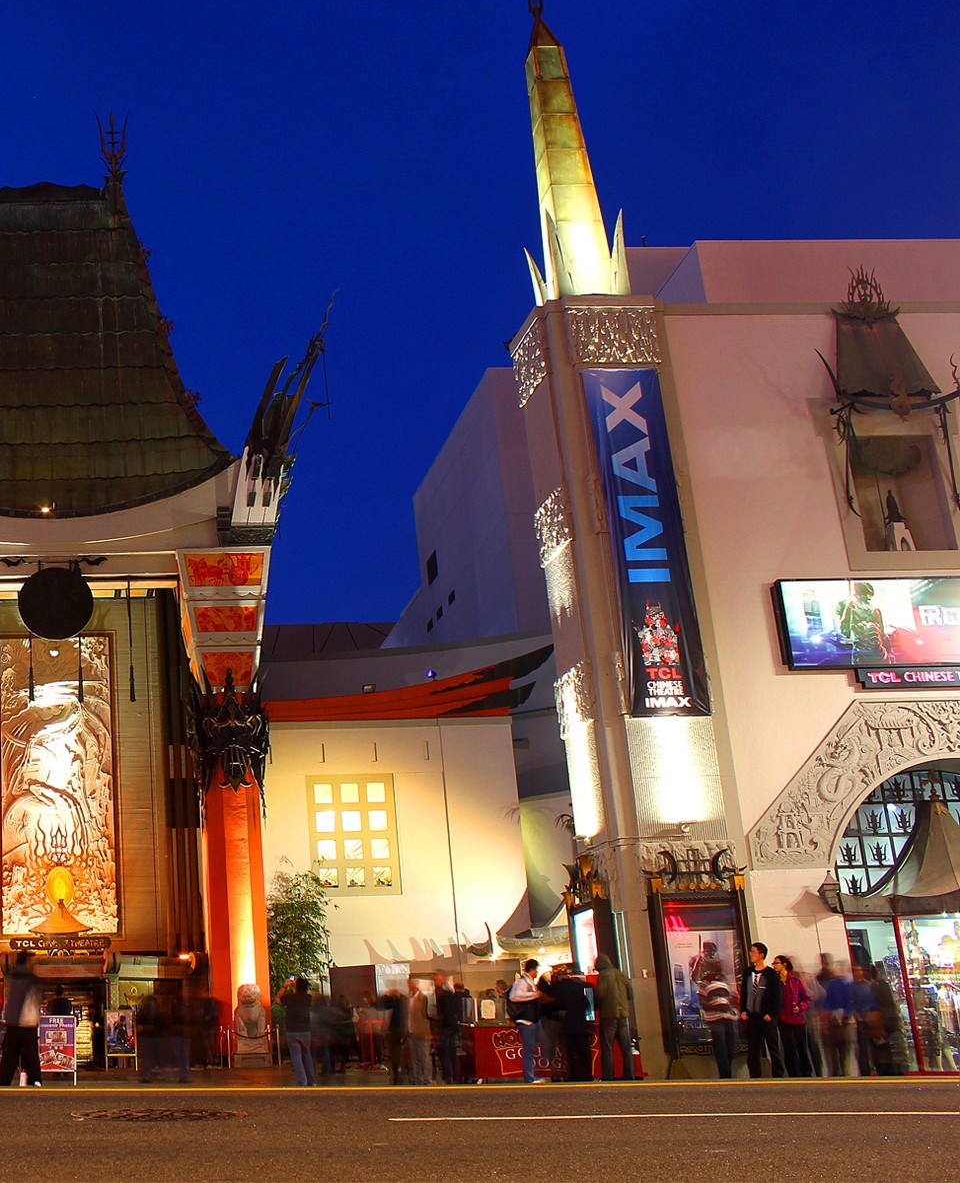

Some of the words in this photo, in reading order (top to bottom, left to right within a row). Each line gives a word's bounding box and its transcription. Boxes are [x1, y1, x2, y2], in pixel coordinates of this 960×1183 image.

[600, 380, 672, 583] IMAX
[645, 667, 683, 680] TCL
[868, 671, 902, 684] TCL
[904, 671, 955, 683] CHINESE
[646, 680, 683, 689] CHINESE
[647, 688, 685, 696] THEATRE
[644, 697, 692, 708] IMAX
[15, 939, 36, 948] TCL
[70, 939, 105, 948] THEATRE
